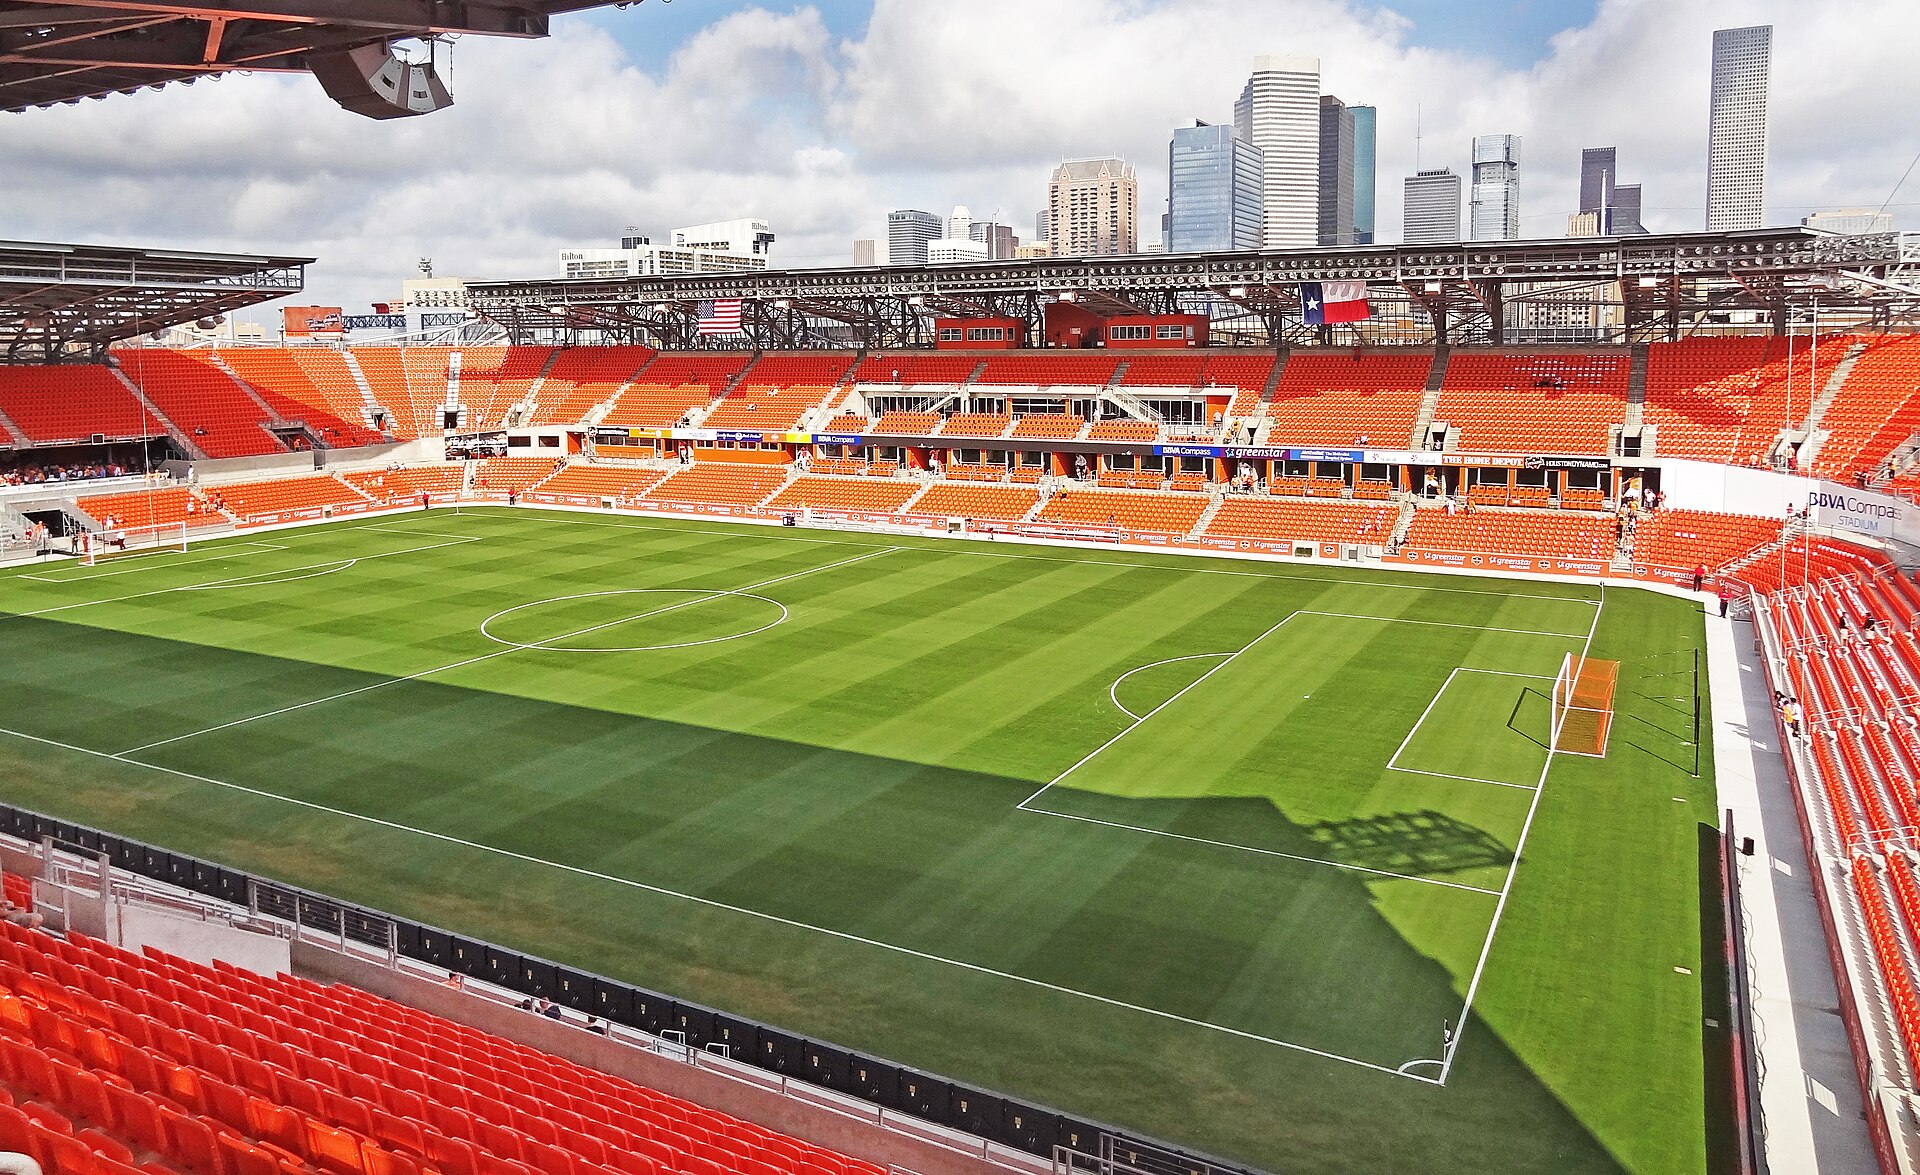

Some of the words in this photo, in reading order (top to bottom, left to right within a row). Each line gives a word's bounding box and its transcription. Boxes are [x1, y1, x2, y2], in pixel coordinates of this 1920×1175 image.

[751, 222, 768, 230] Hilton
[561, 252, 583, 261] Hilton
[831, 436, 855, 444] Compass
[1180, 447, 1211, 456] Compass
[1235, 448, 1285, 458] greenstar
[1442, 456, 1462, 464] THE
[1463, 456, 1490, 465] HOME
[1492, 457, 1523, 466] DEPOT
[1809, 492, 1845, 511] BBVA
[1838, 515, 1878, 531] STADIUM
[1431, 553, 1465, 562] greenstar
[1496, 557, 1532, 566] greenstar
[1564, 563, 1602, 571] greenstar
